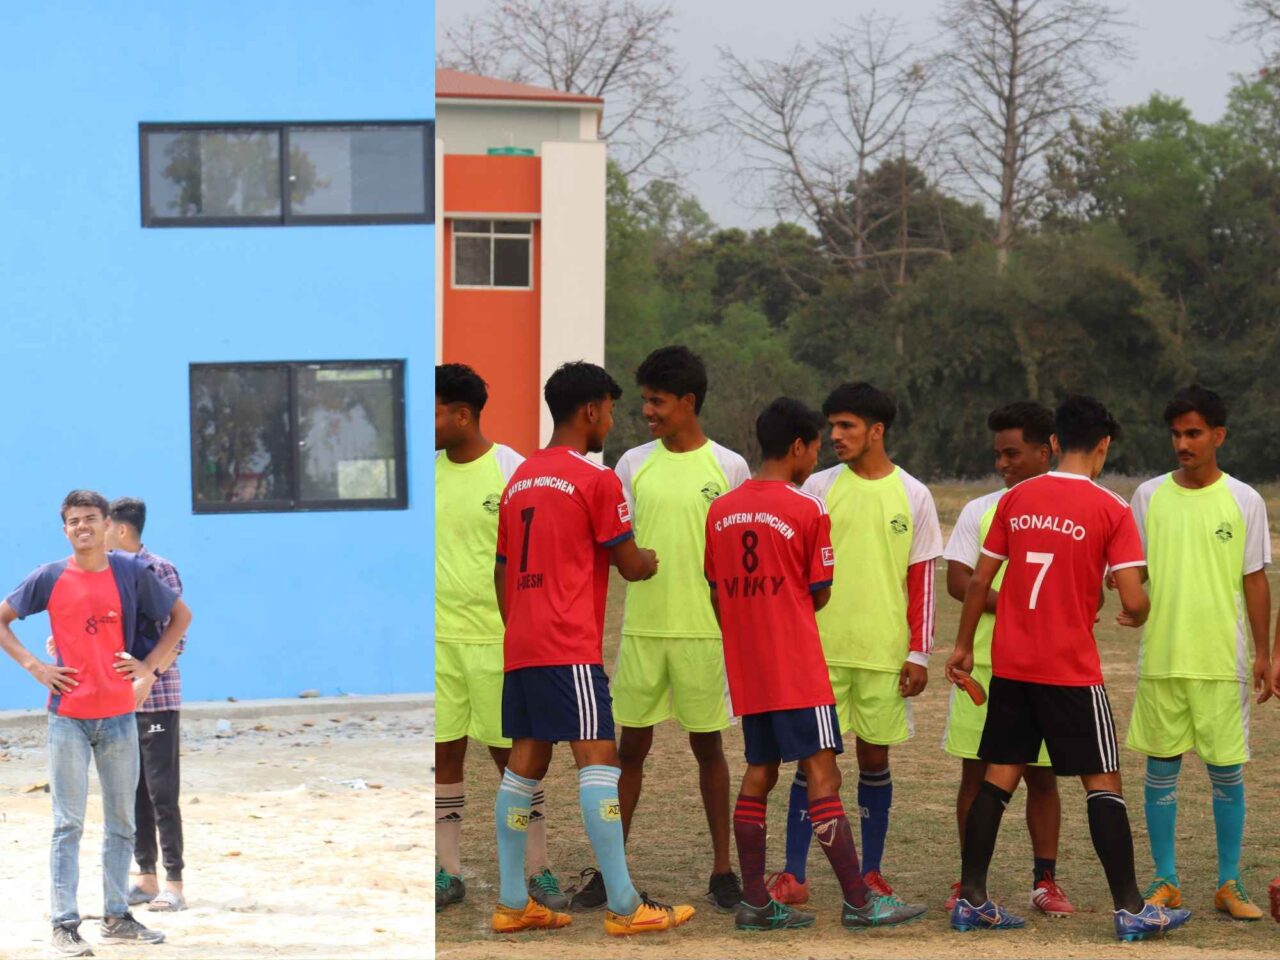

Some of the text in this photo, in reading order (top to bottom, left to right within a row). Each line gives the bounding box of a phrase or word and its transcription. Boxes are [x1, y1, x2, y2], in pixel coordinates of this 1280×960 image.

[723, 512, 753, 528] BAYERN
[1010, 514, 1086, 541] RONALDO
[742, 530, 759, 574] 8
[1026, 551, 1055, 610] 7
